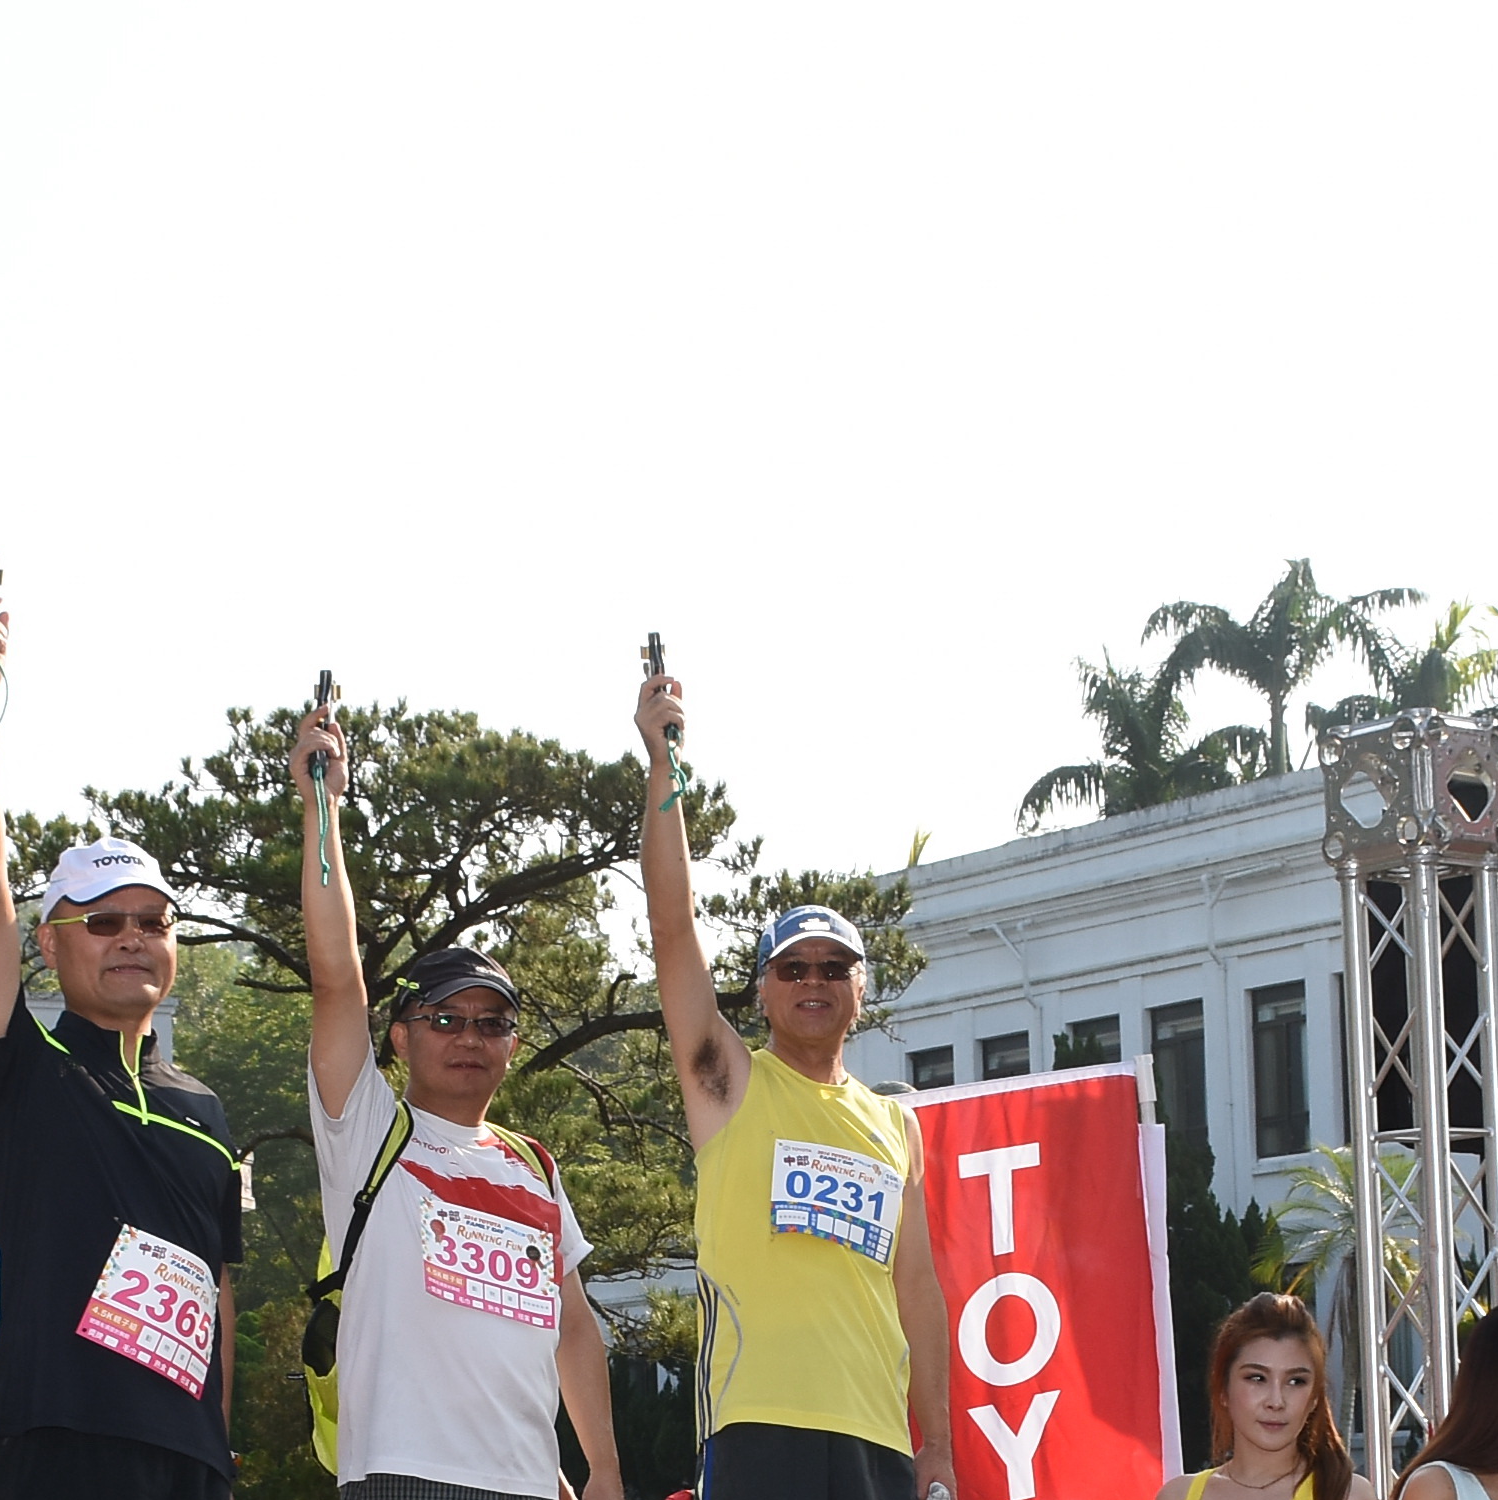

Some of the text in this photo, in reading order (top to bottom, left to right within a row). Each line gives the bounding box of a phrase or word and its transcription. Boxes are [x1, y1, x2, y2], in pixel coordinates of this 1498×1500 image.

[92, 854, 146, 869] TOYOTA
[786, 1170, 885, 1222] 0231
[139, 1241, 167, 1259] 中部
[457, 1225, 502, 1246] RUNNING
[505, 1239, 523, 1252] FUN
[435, 1235, 539, 1289] 3309
[154, 1263, 200, 1295] RUNNING
[111, 1269, 212, 1350] 2365
